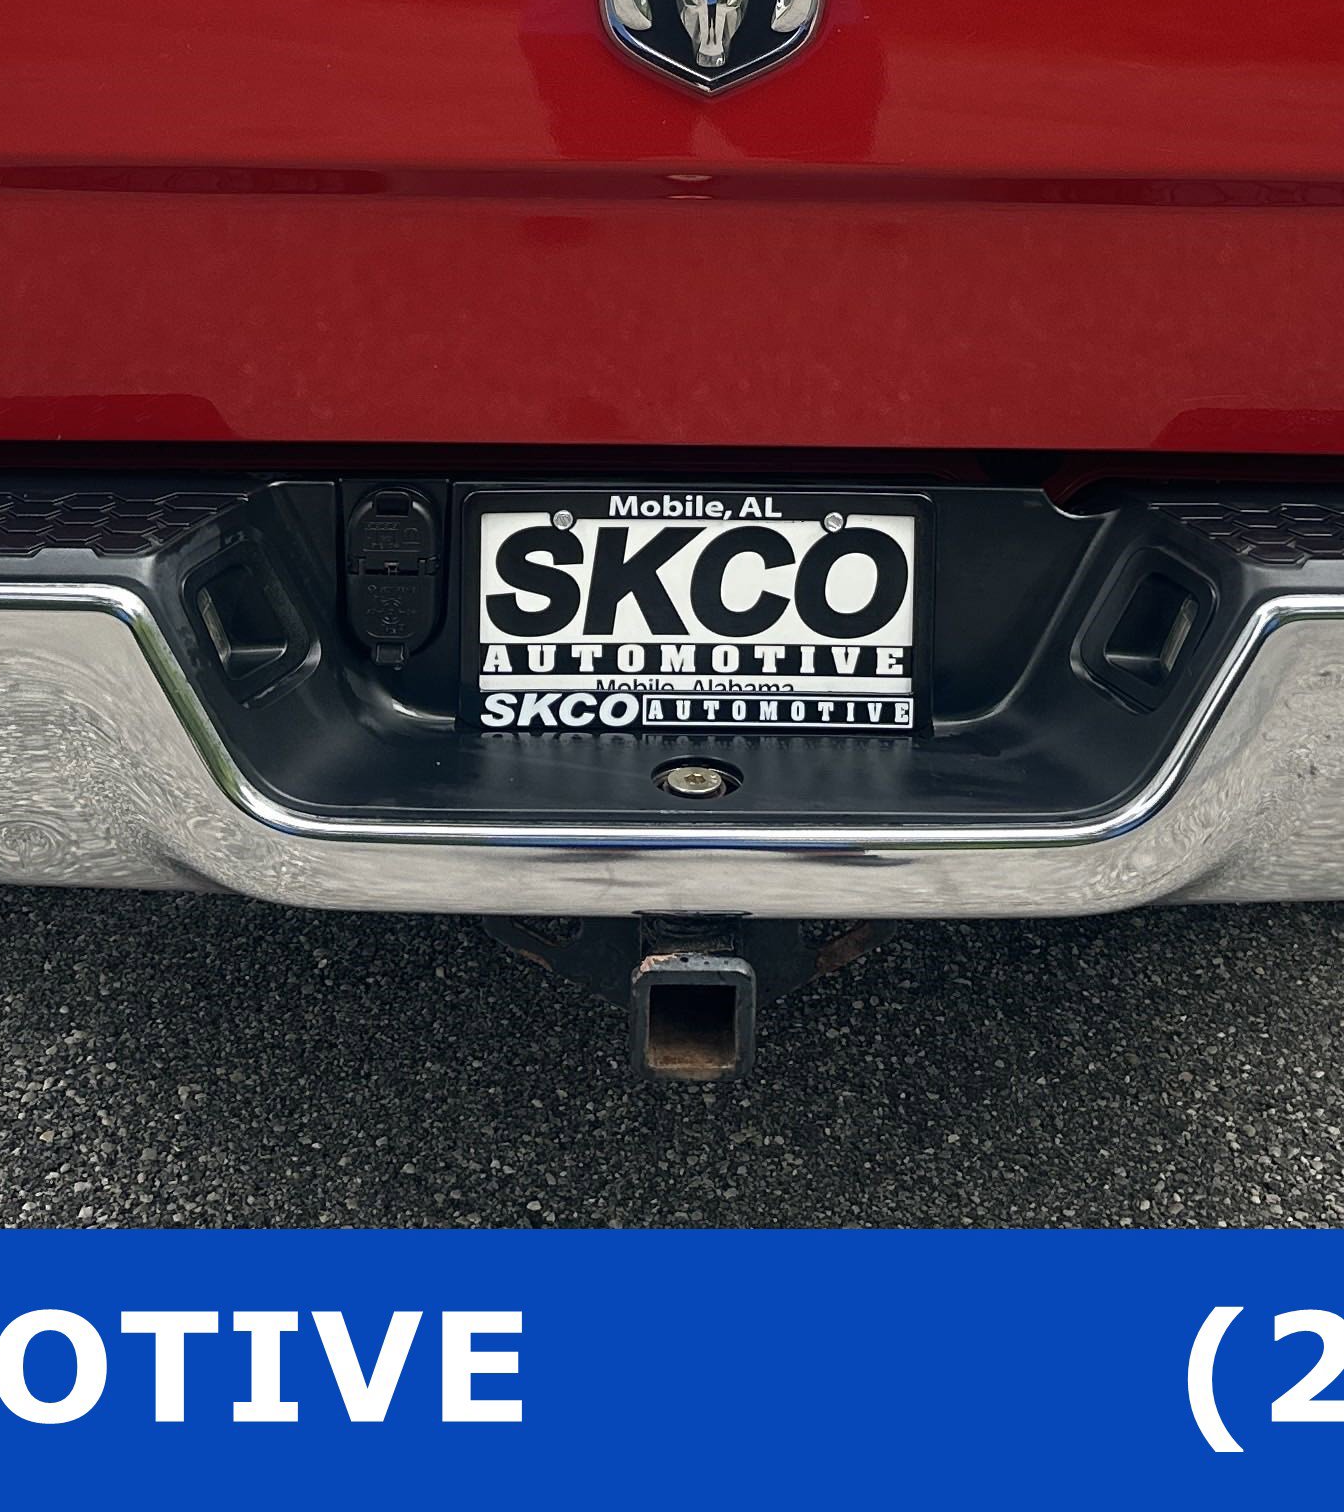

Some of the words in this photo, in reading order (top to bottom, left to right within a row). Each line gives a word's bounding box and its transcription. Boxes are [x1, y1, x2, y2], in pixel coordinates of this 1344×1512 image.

[609, 495, 730, 520] Mobile,
[739, 496, 783, 518] AL
[486, 525, 909, 639] SKCO
[483, 644, 905, 675] AUTOMOTIVE
[481, 692, 641, 727] SKCO
[647, 699, 910, 724] AUTOMOTIVE
